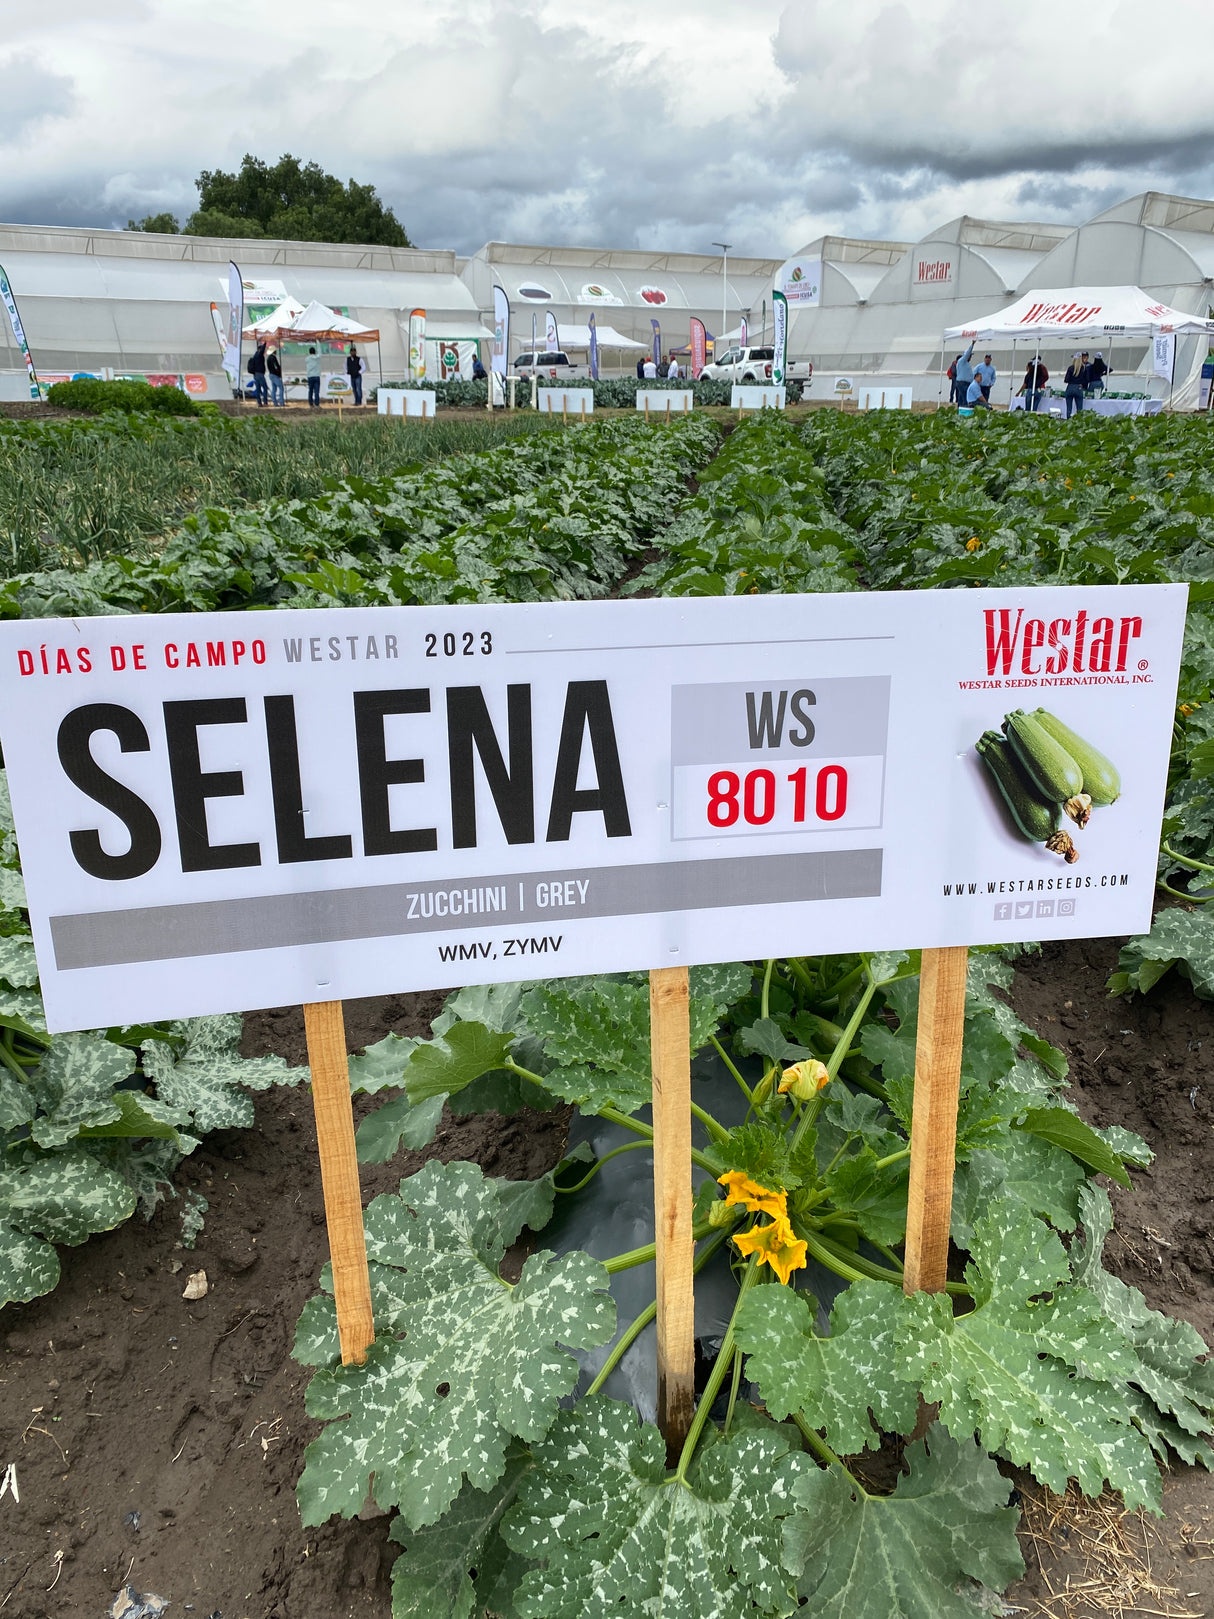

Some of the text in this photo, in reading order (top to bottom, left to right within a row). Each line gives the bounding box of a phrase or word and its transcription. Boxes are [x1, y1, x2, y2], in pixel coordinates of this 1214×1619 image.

[918, 260, 951, 280] Westar
[1019, 303, 1102, 324] Westar
[18, 631, 493, 676] DÍAS DE CAMPO WESTAR 2023
[983, 608, 1143, 675] Westar
[958, 674, 1154, 690] WESTAR SEEDS INTERNATIONAL, INC.
[745, 689, 817, 749] WS
[57, 680, 632, 880] SELENA
[706, 765, 849, 828] 8010
[406, 886, 506, 919] ZUCCHINI
[536, 880, 590, 908] GREY
[943, 874, 1129, 896] WWW.WESTARSEEDS.COM
[438, 936, 563, 962] WMV, ZYMV
